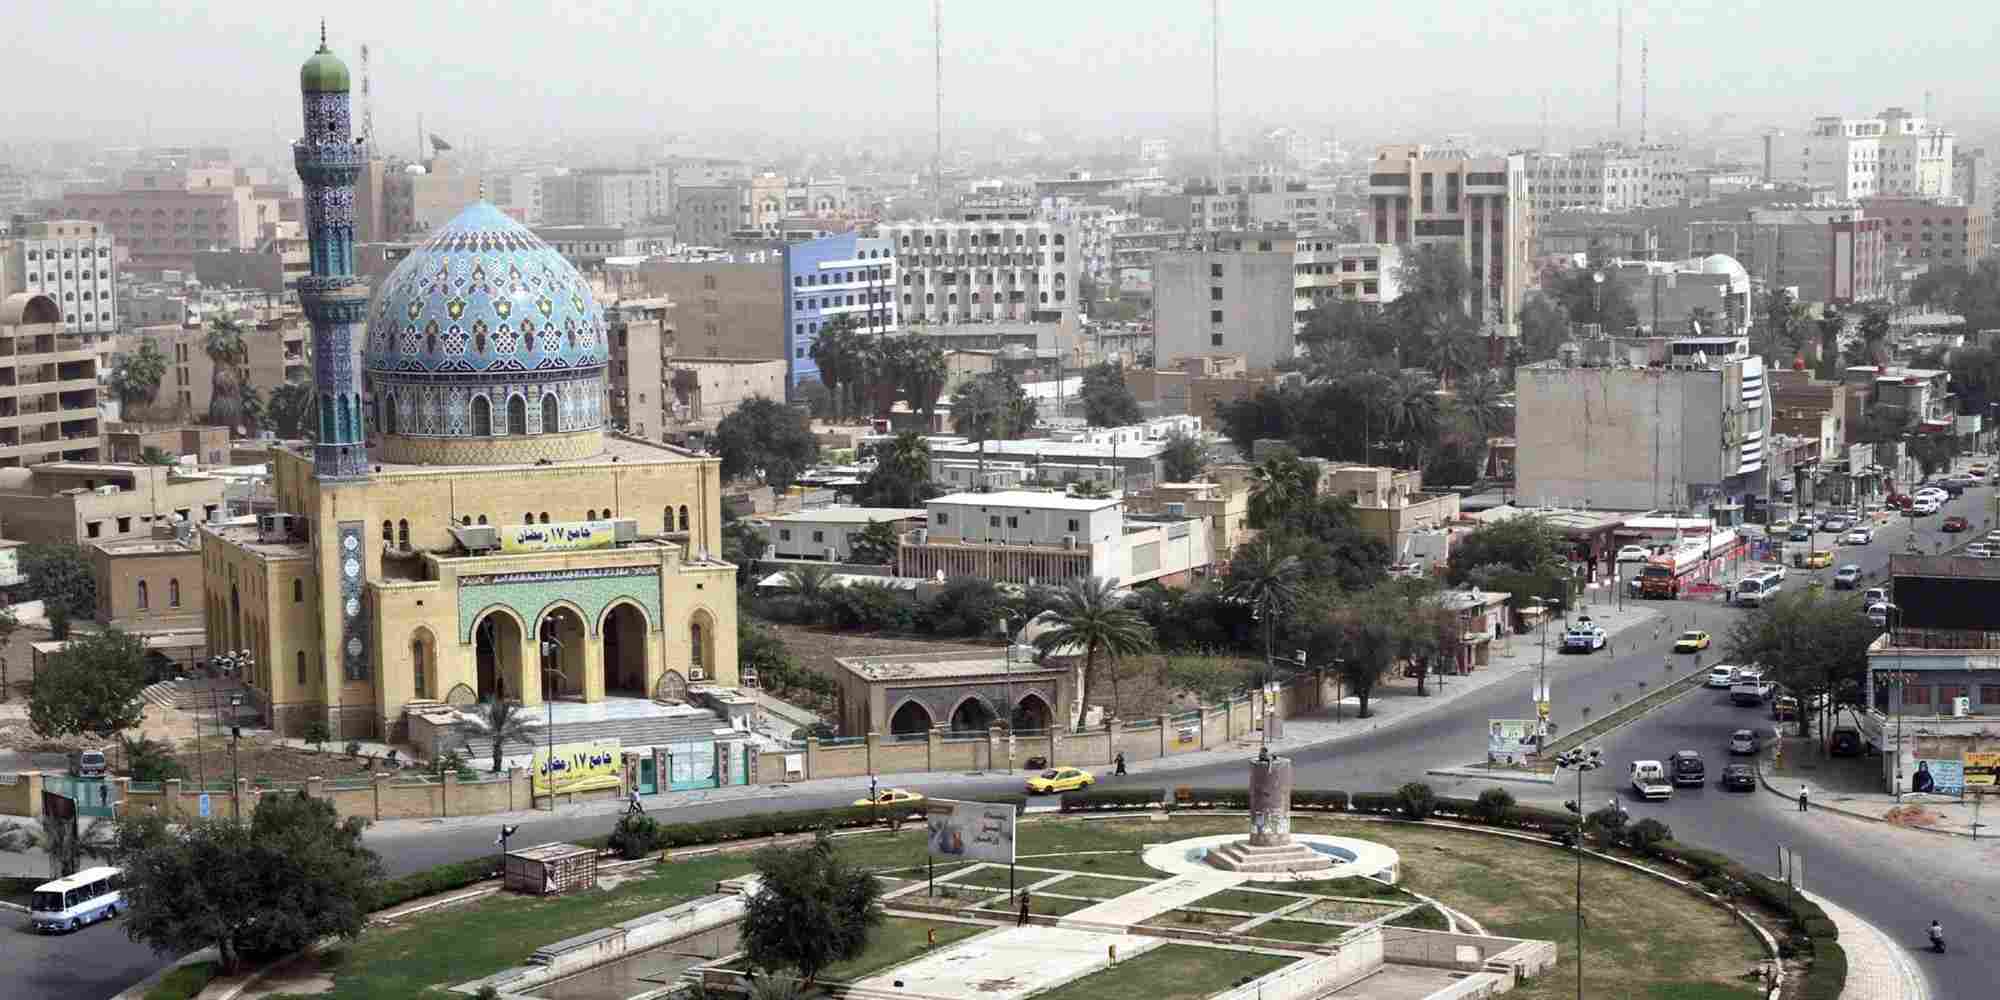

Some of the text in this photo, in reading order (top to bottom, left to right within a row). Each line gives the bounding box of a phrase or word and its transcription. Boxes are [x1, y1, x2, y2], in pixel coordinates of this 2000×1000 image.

[517, 527, 591, 544] جامع ١٧ رمضان
[541, 750, 612, 776] جامع ١٧ رمضان
